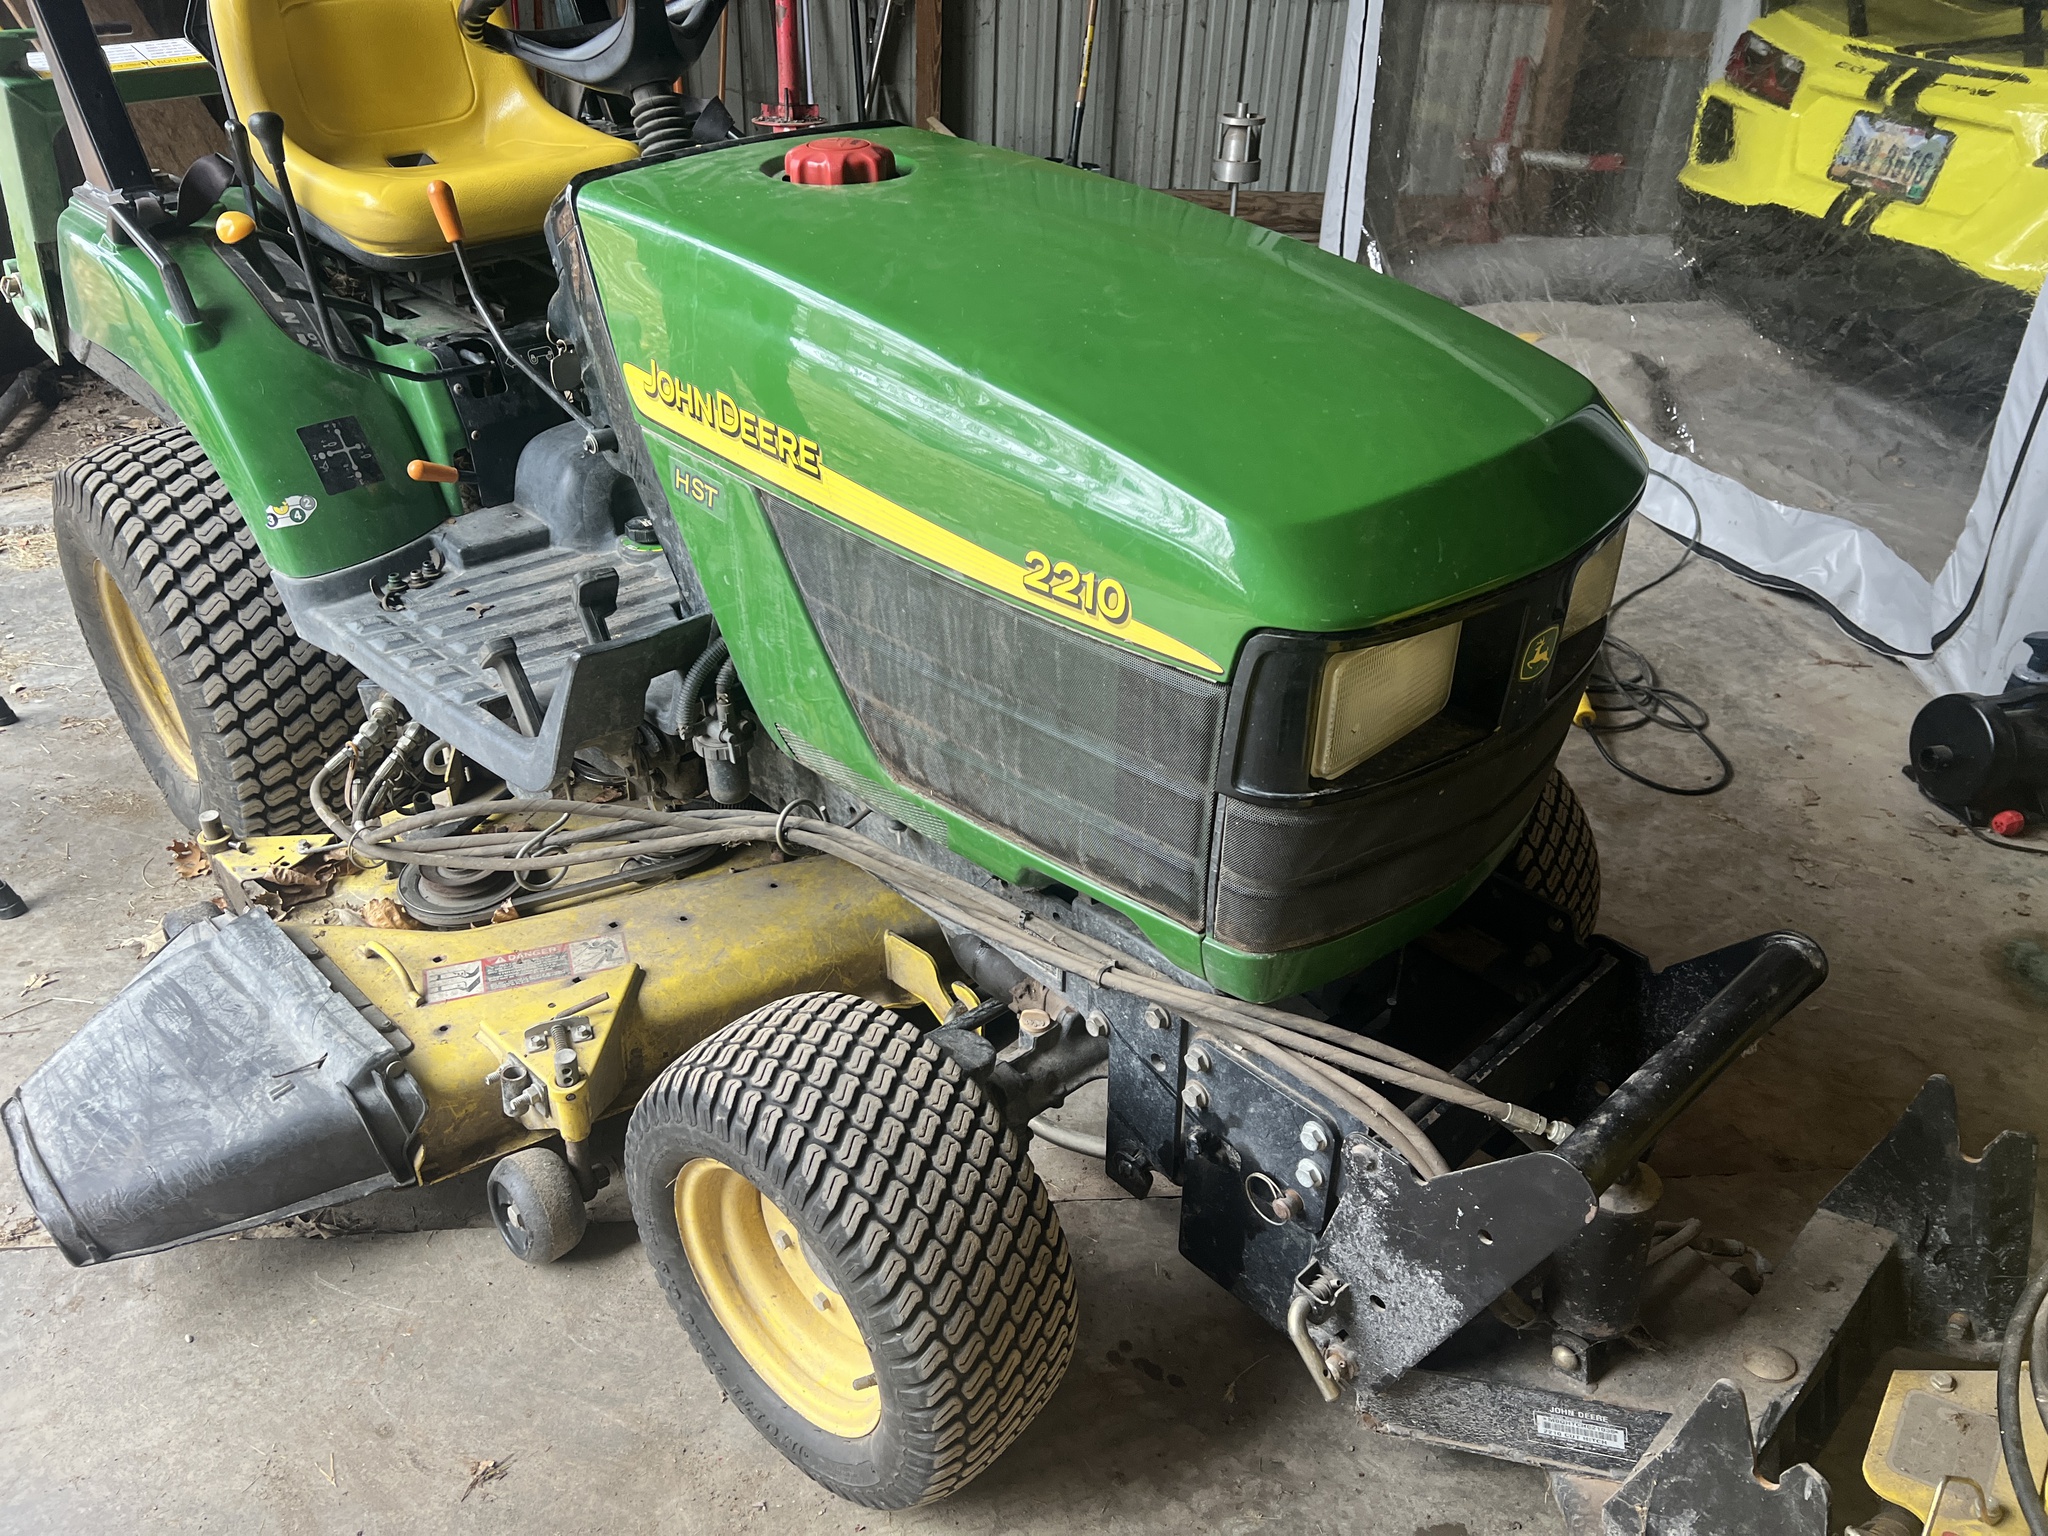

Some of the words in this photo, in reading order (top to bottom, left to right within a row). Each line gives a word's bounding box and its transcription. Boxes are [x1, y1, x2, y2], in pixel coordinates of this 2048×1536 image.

[280, 312, 300, 323] N
[644, 358, 716, 430] JOHN
[716, 388, 822, 480] DEERE
[674, 466, 719, 509] HST
[294, 510, 302, 520] 4
[1023, 550, 1130, 626] 2210
[508, 946, 556, 960] DANGER
[1550, 1406, 1574, 1416] JOHN
[1578, 1411, 1608, 1422] DEERE
